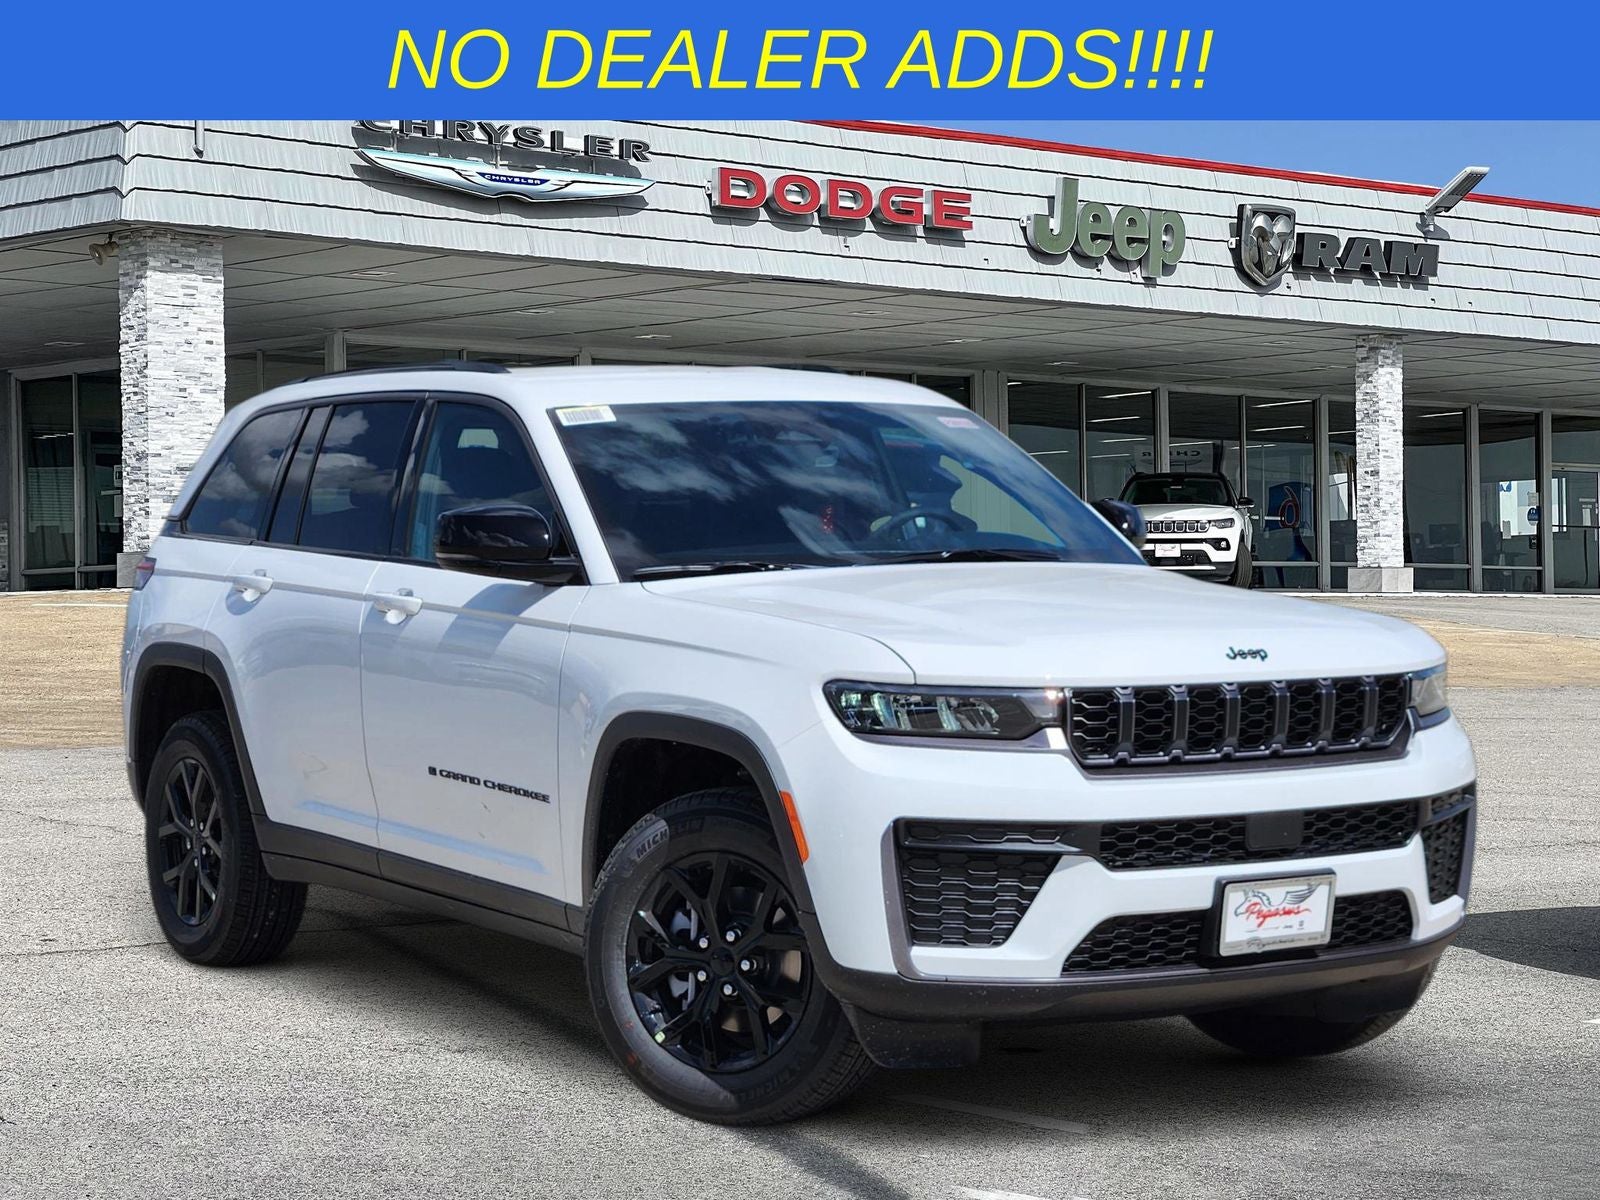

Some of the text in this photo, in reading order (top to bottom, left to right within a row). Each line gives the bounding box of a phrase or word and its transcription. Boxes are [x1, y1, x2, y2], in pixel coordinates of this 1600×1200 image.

[484, 174, 541, 185] CHRYSLER
[711, 165, 973, 231] DODGE
[1028, 176, 1186, 278] Jeep
[1300, 232, 1440, 277] RAM
[1226, 646, 1268, 662] Jeep
[439, 769, 551, 804] GRAND CHEROKEE
